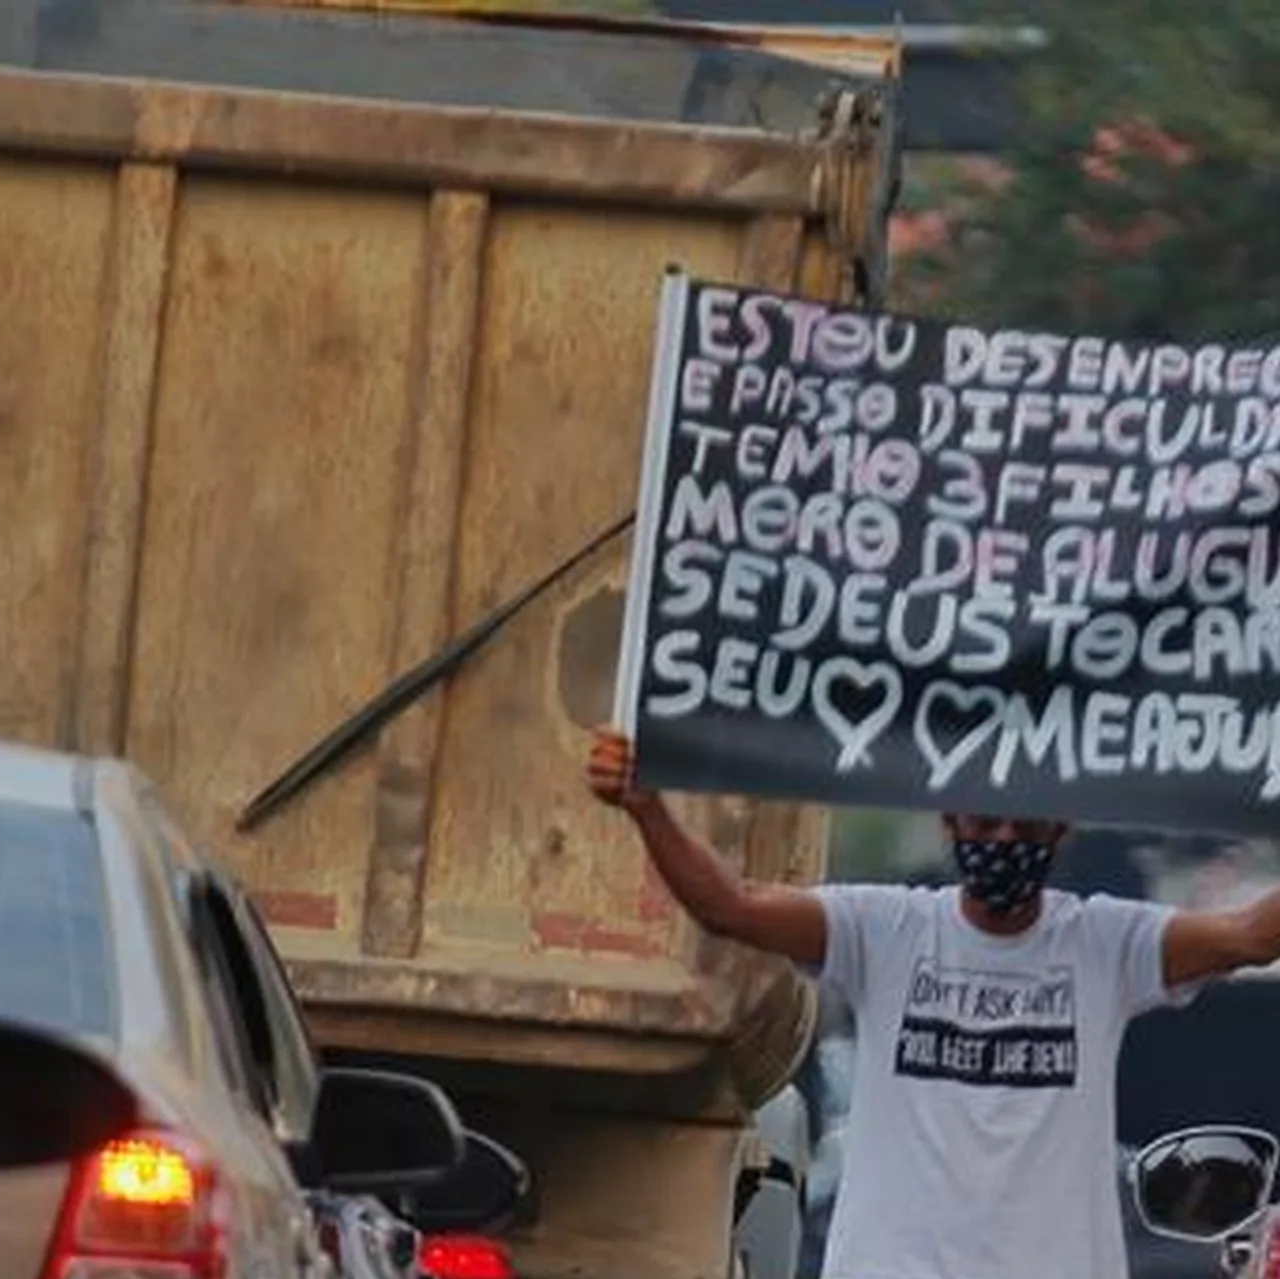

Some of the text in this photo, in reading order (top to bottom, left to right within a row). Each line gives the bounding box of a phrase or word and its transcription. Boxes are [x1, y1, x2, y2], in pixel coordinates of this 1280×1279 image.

[700, 291, 916, 369] ESTOU
[681, 358, 719, 412] E
[730, 364, 897, 434] PASSO
[926, 450, 988, 521] 3
[665, 473, 901, 570] MORO
[910, 519, 1028, 594] DE
[646, 629, 811, 718] SEU
